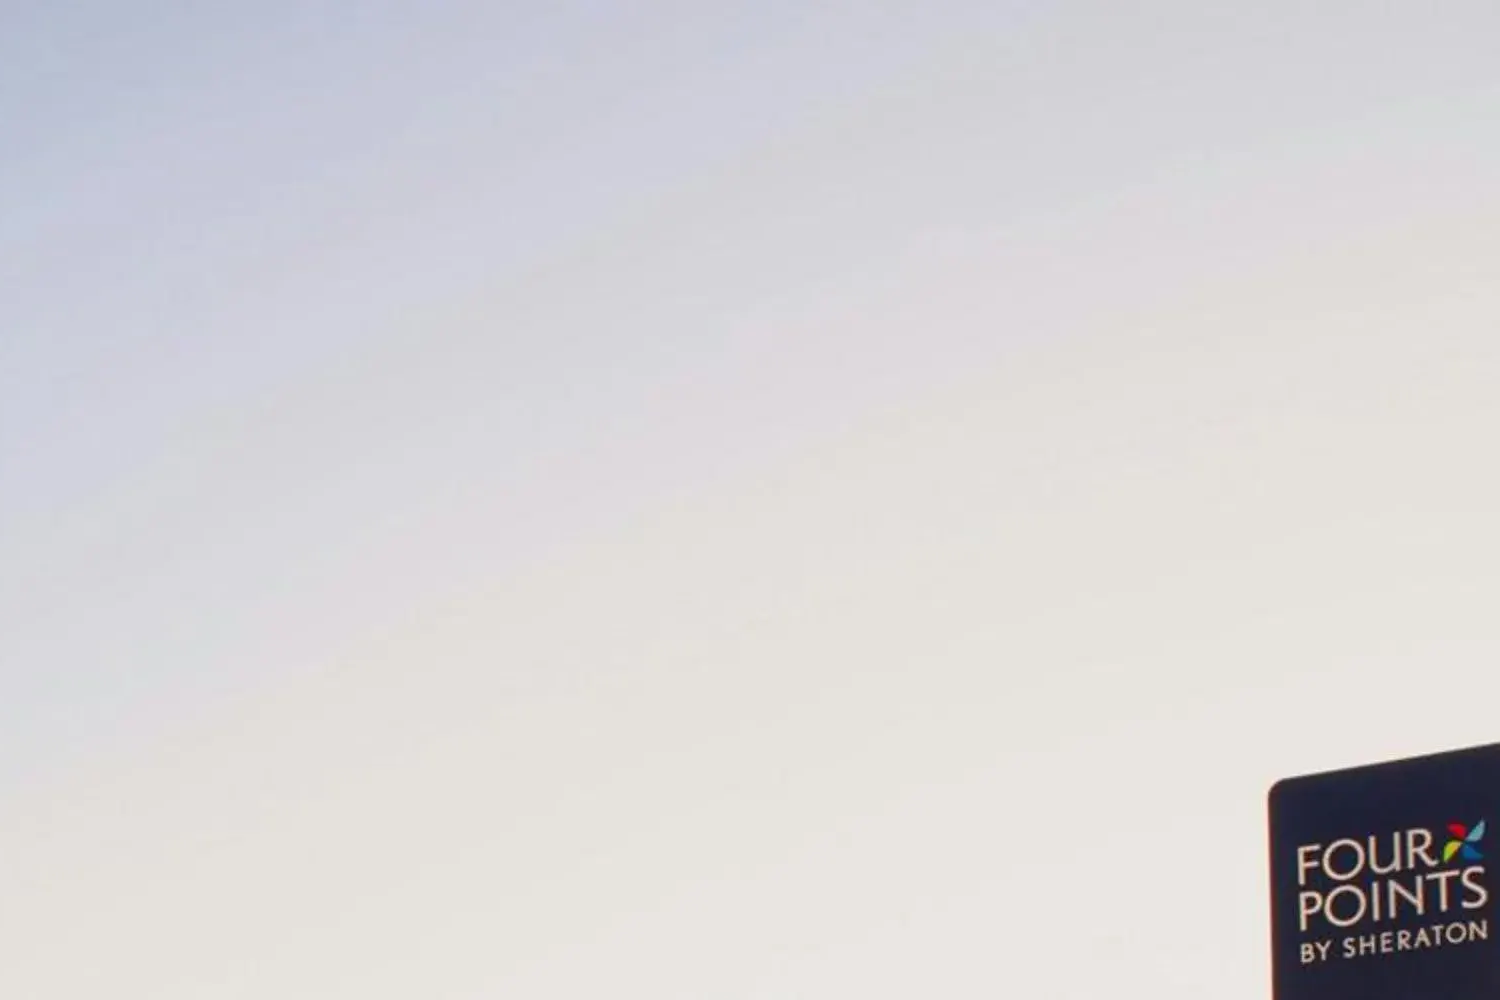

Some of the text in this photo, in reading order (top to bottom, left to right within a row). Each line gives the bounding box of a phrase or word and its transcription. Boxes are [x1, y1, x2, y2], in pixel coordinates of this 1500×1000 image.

[1297, 828, 1439, 886] FOUR
[1299, 866, 1489, 932] POINTS
[1300, 920, 1488, 964] BY SHERATON
